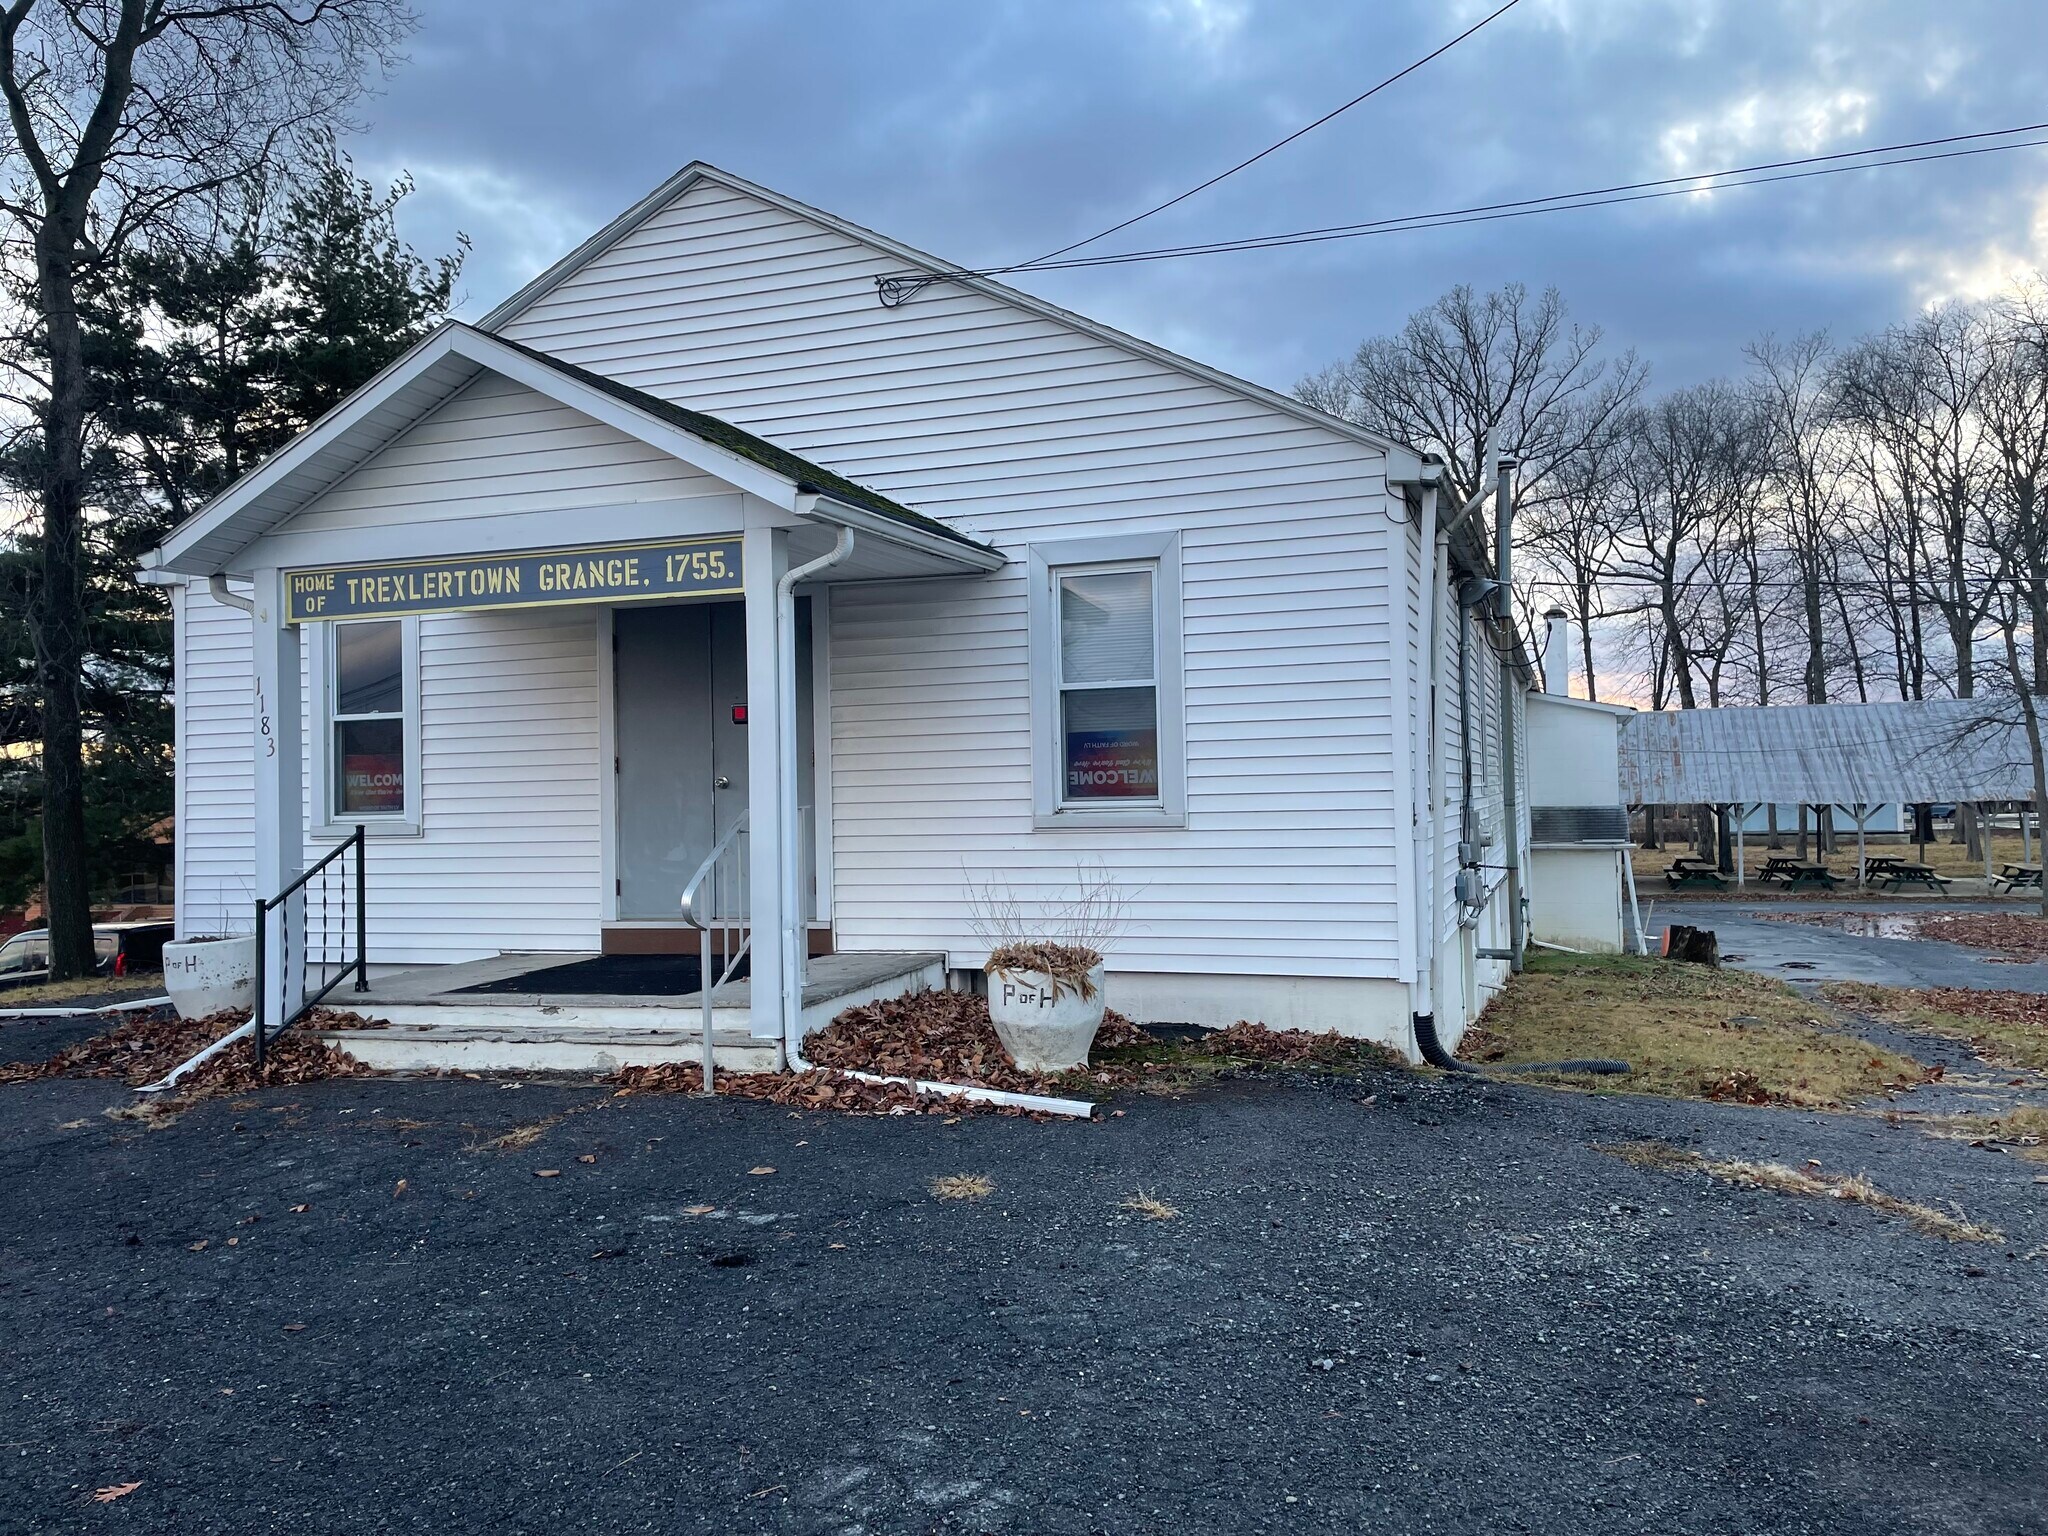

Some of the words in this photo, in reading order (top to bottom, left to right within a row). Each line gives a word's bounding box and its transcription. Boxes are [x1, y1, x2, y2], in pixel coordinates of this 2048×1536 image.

[295, 574, 335, 593] HOME
[346, 566, 520, 604] TREXLERTOWN
[539, 558, 650, 591] GRANGE,
[665, 550, 734, 583] 1755.
[305, 596, 326, 613] OF
[256, 676, 275, 757] 1183
[1069, 769, 1156, 785] WELCOME
[165, 957, 171, 973] P
[185, 955, 197, 973] H
[1003, 984, 1016, 1006] P
[1039, 987, 1055, 1009] H
